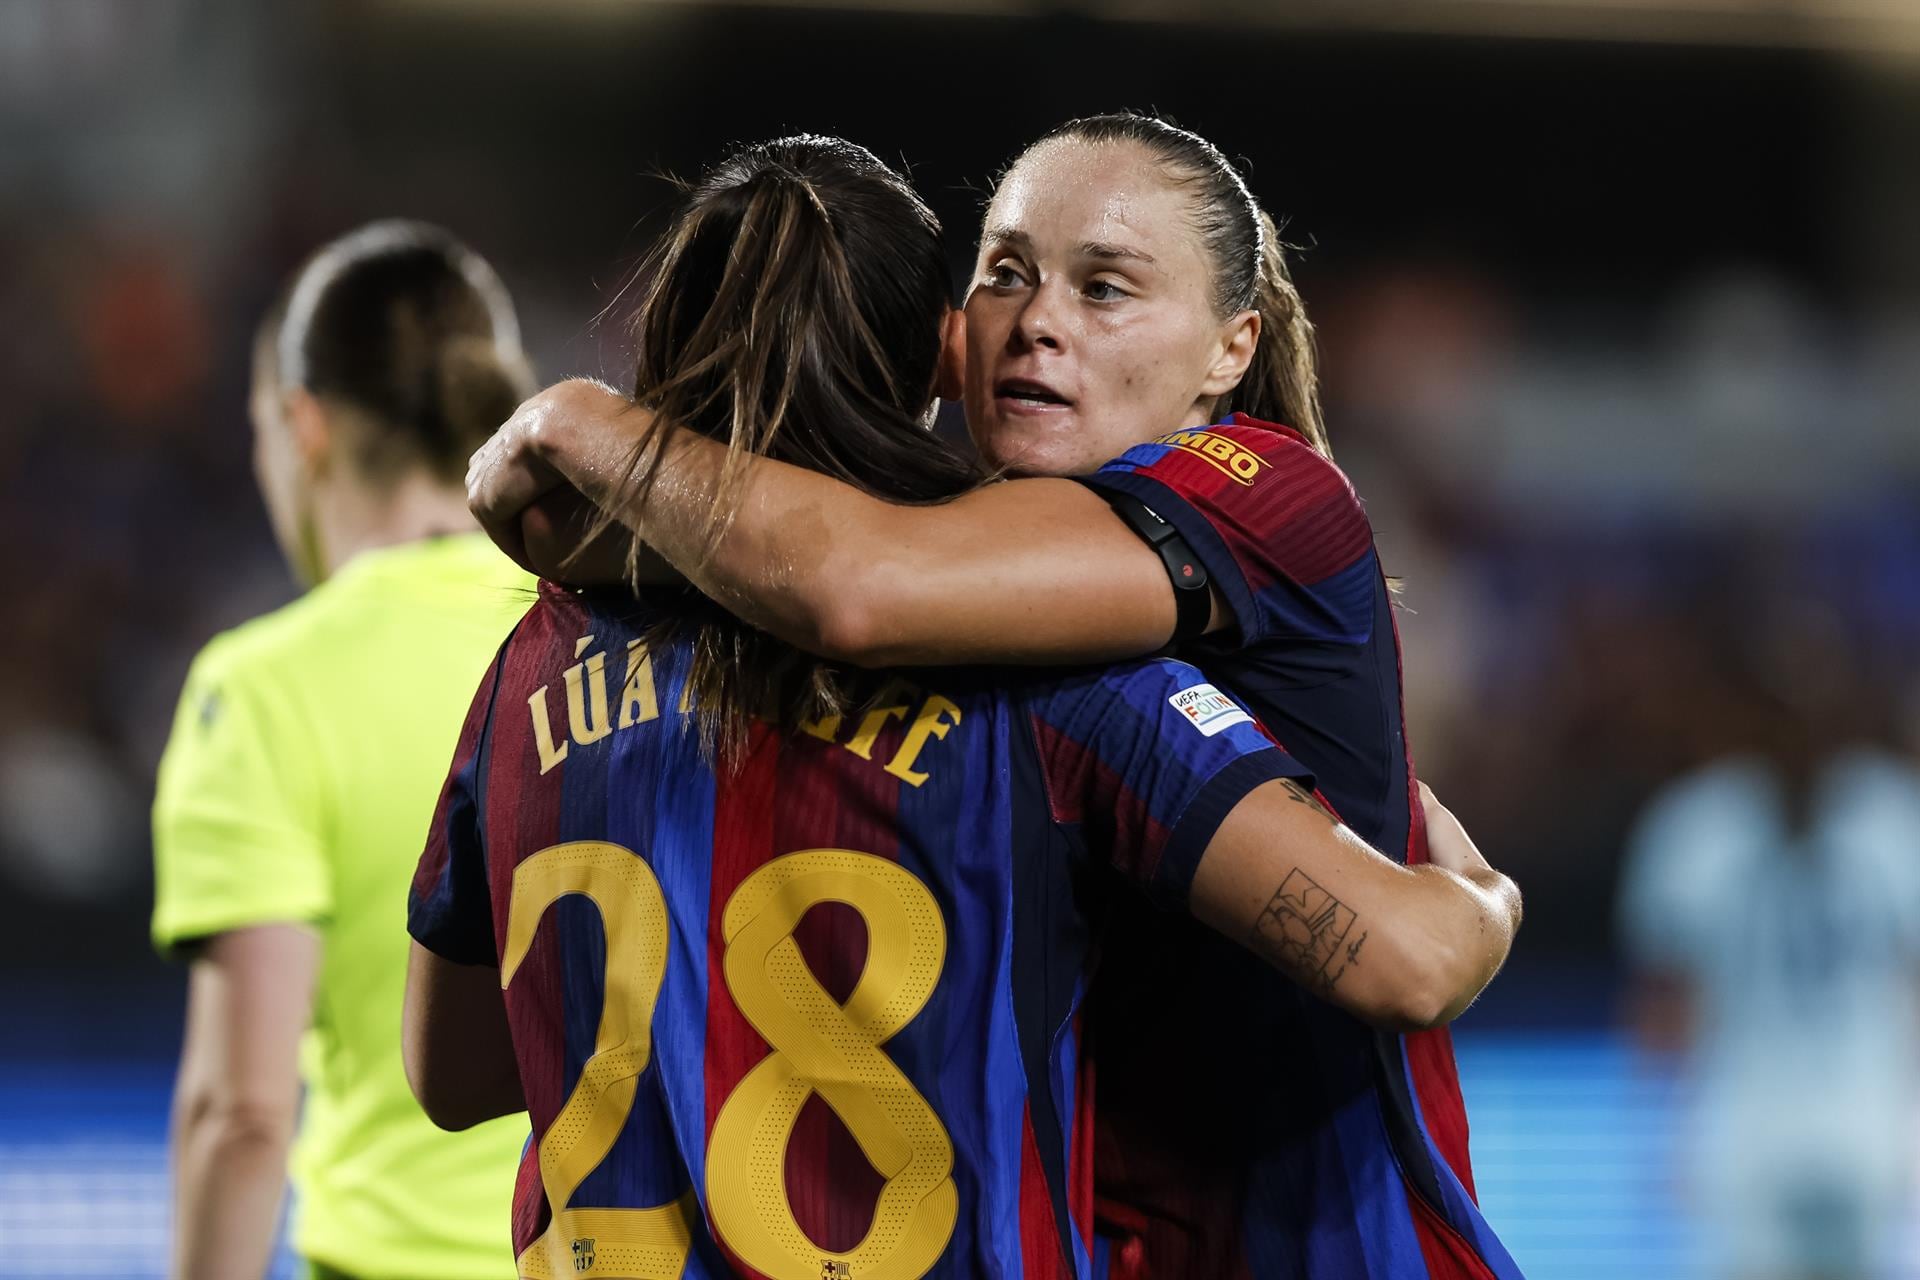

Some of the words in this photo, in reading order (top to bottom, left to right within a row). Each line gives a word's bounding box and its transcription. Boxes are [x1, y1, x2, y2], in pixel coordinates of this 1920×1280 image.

[1155, 431, 1260, 480] IMBO
[526, 633, 660, 777] LÚA
[1174, 690, 1202, 708] UEFA
[501, 839, 959, 1280] 28
